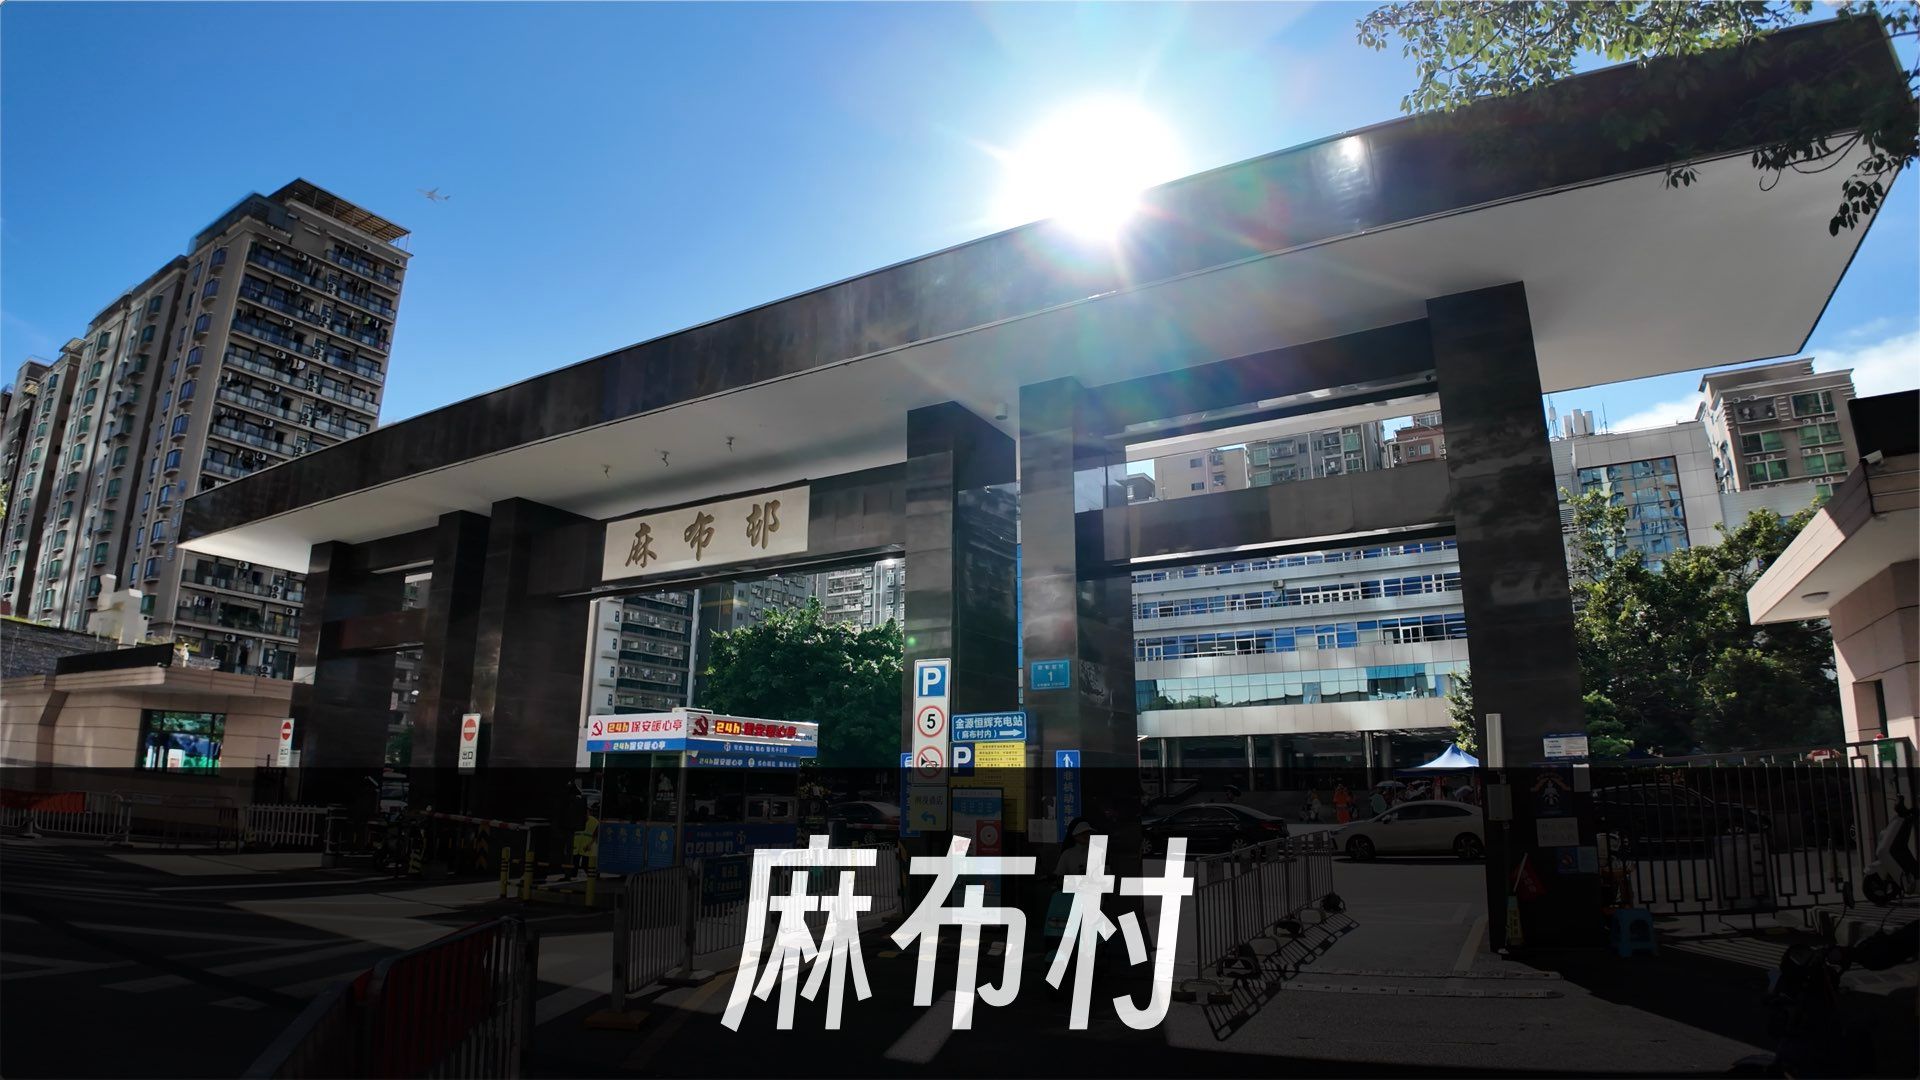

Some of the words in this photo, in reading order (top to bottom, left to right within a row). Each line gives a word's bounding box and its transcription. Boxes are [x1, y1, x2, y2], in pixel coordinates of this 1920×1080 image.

[922, 667, 942, 695] P
[1047, 671, 1054, 682] 1
[926, 713, 936, 729] 5
[955, 715, 1024, 729] 金源恒辉充电站
[953, 746, 972, 774] P
